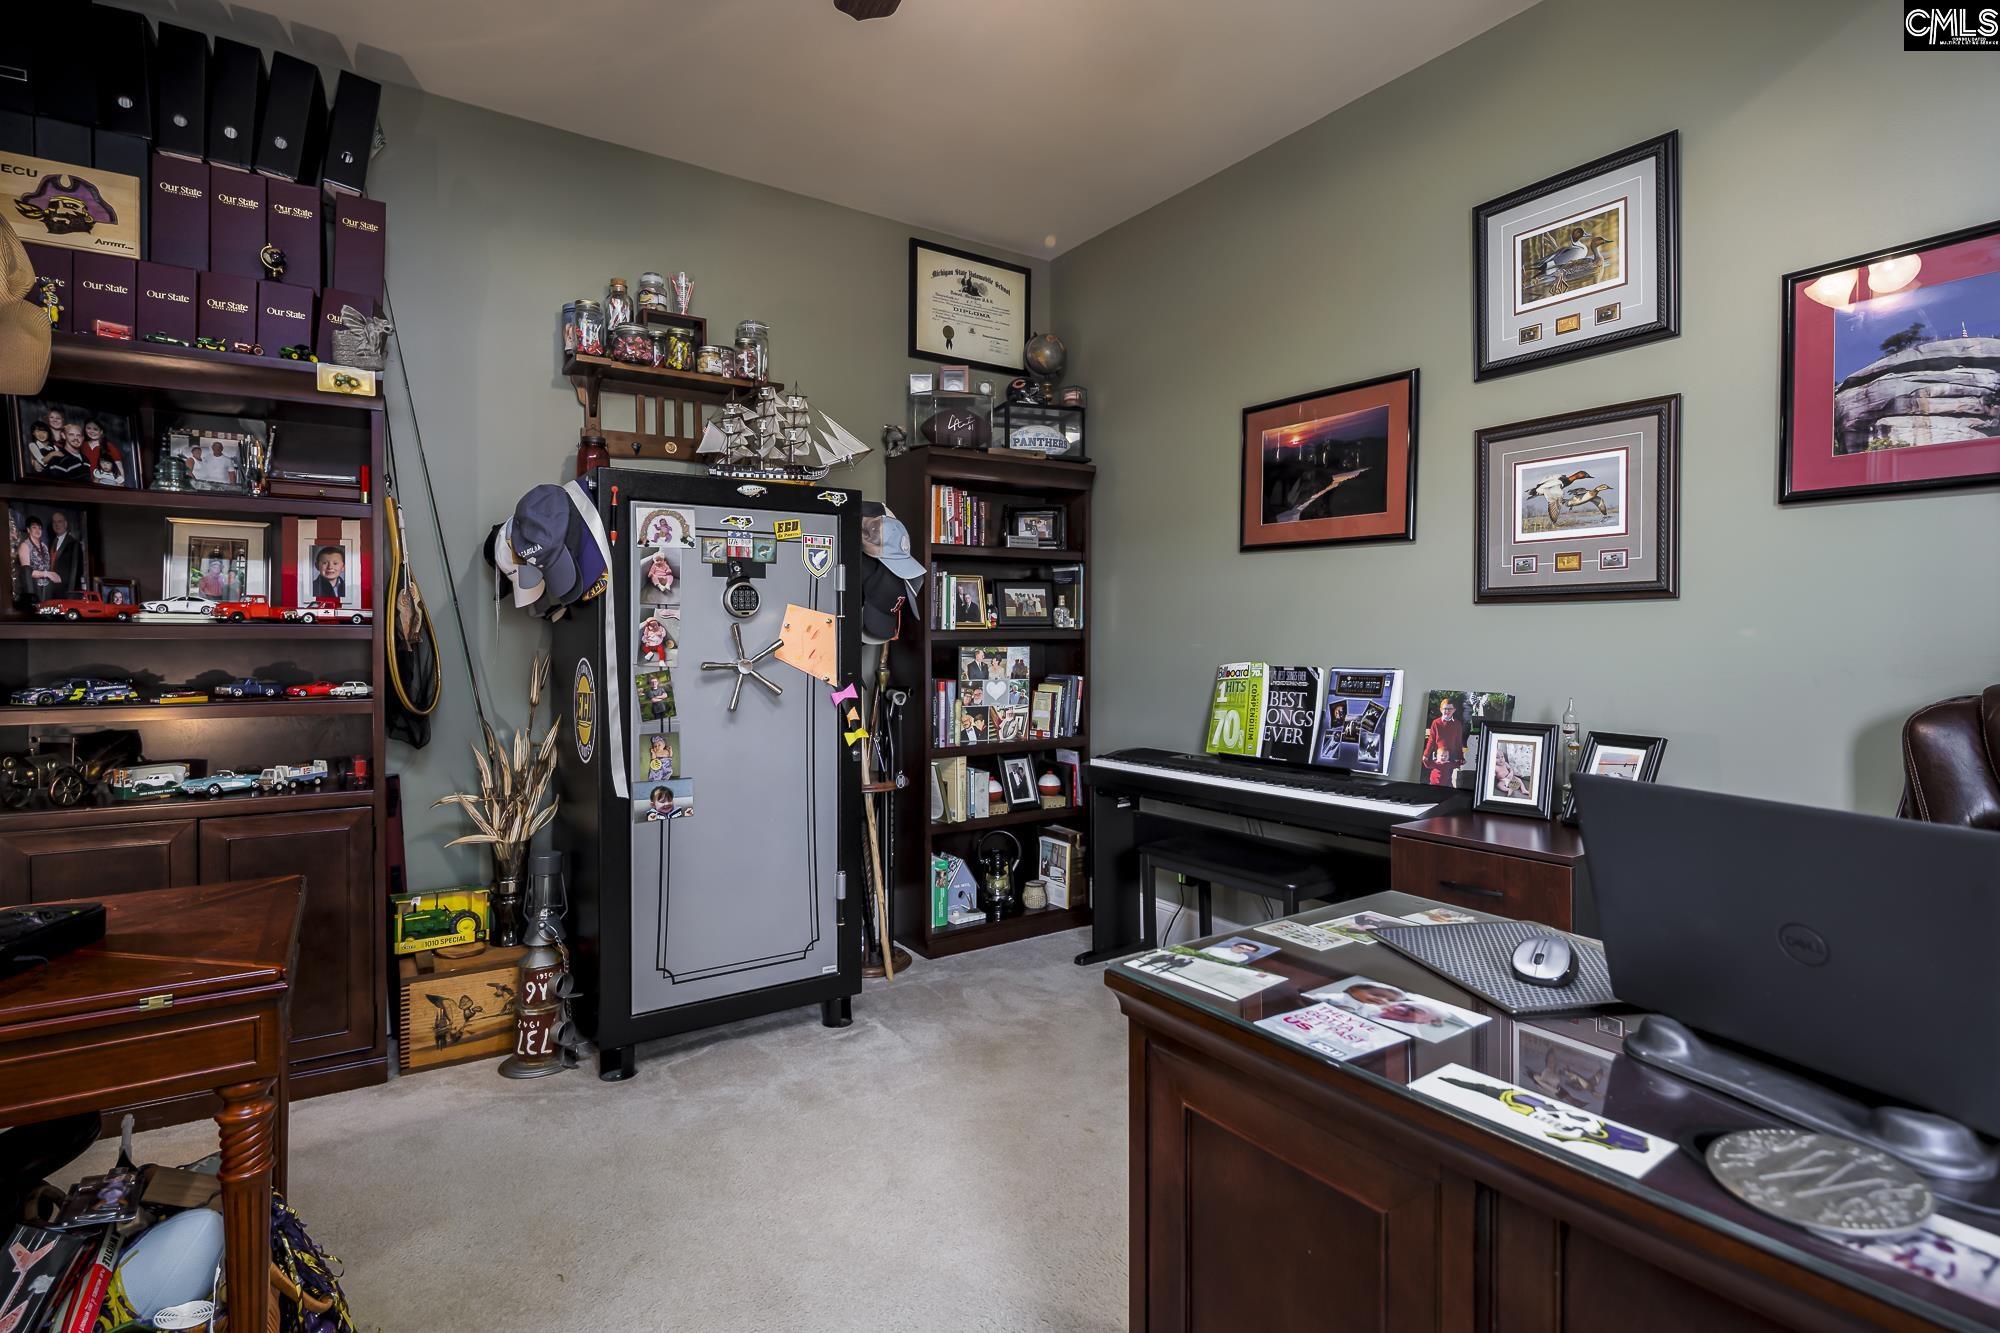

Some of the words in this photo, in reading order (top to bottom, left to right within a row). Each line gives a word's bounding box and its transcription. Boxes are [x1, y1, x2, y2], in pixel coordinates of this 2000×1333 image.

[1, 164, 38, 178] ECU
[160, 182, 179, 193] Our
[180, 186, 202, 197] State
[218, 194, 237, 204] Our
[238, 197, 258, 208] State
[274, 204, 292, 213] Our
[292, 207, 312, 218] State
[342, 217, 359, 226] Our
[360, 220, 378, 232] State
[83, 280, 104, 290] Our
[105, 283, 128, 294] State
[146, 290, 166, 300] Our
[168, 292, 190, 303] State
[207, 298, 226, 308] Our
[227, 301, 248, 312] State
[266, 307, 285, 316] Our
[286, 310, 305, 320] State
[953, 307, 990, 319] DIPLOMA
[1012, 437, 1068, 449] PANTHERS
[777, 521, 798, 533] ECU
[1218, 664, 1250, 678] Billboard
[1226, 680, 1247, 692] HITS
[69, 688, 86, 700] 5
[1269, 690, 1307, 708] BEST
[1248, 684, 1258, 740] COMPENDIUM
[1266, 708, 1314, 727] ONGS
[1212, 709, 1245, 749] 70s
[1264, 726, 1304, 745] EVER
[440, 936, 466, 945] SPECIAL
[1283, 1016, 1313, 1031] US
